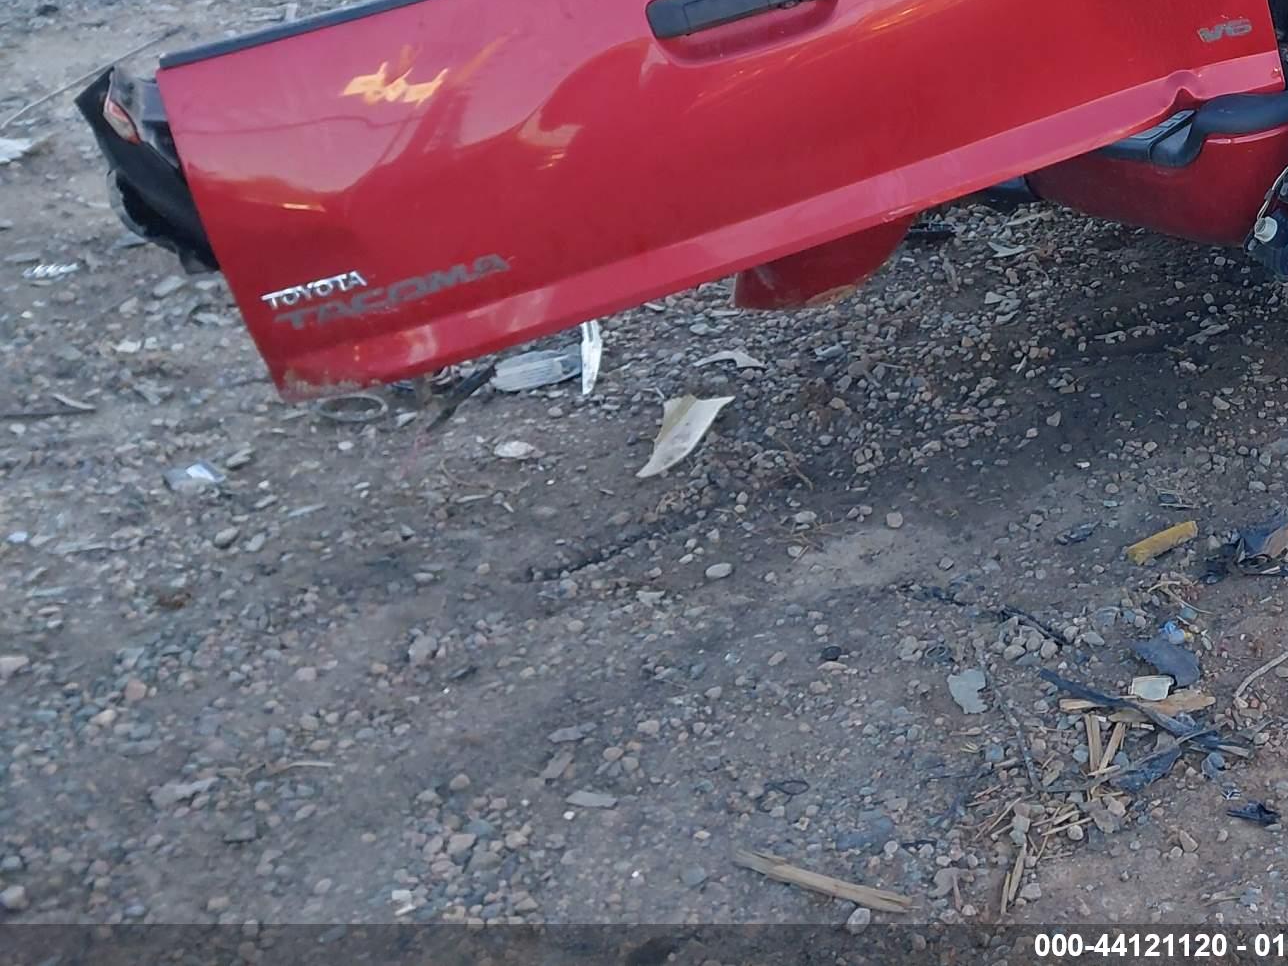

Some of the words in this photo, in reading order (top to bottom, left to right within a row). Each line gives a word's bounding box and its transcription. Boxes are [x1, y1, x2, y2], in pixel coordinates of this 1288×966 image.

[1197, 19, 1253, 43] V6
[261, 270, 368, 311] TOYOTA
[274, 253, 512, 331] TACOMA
